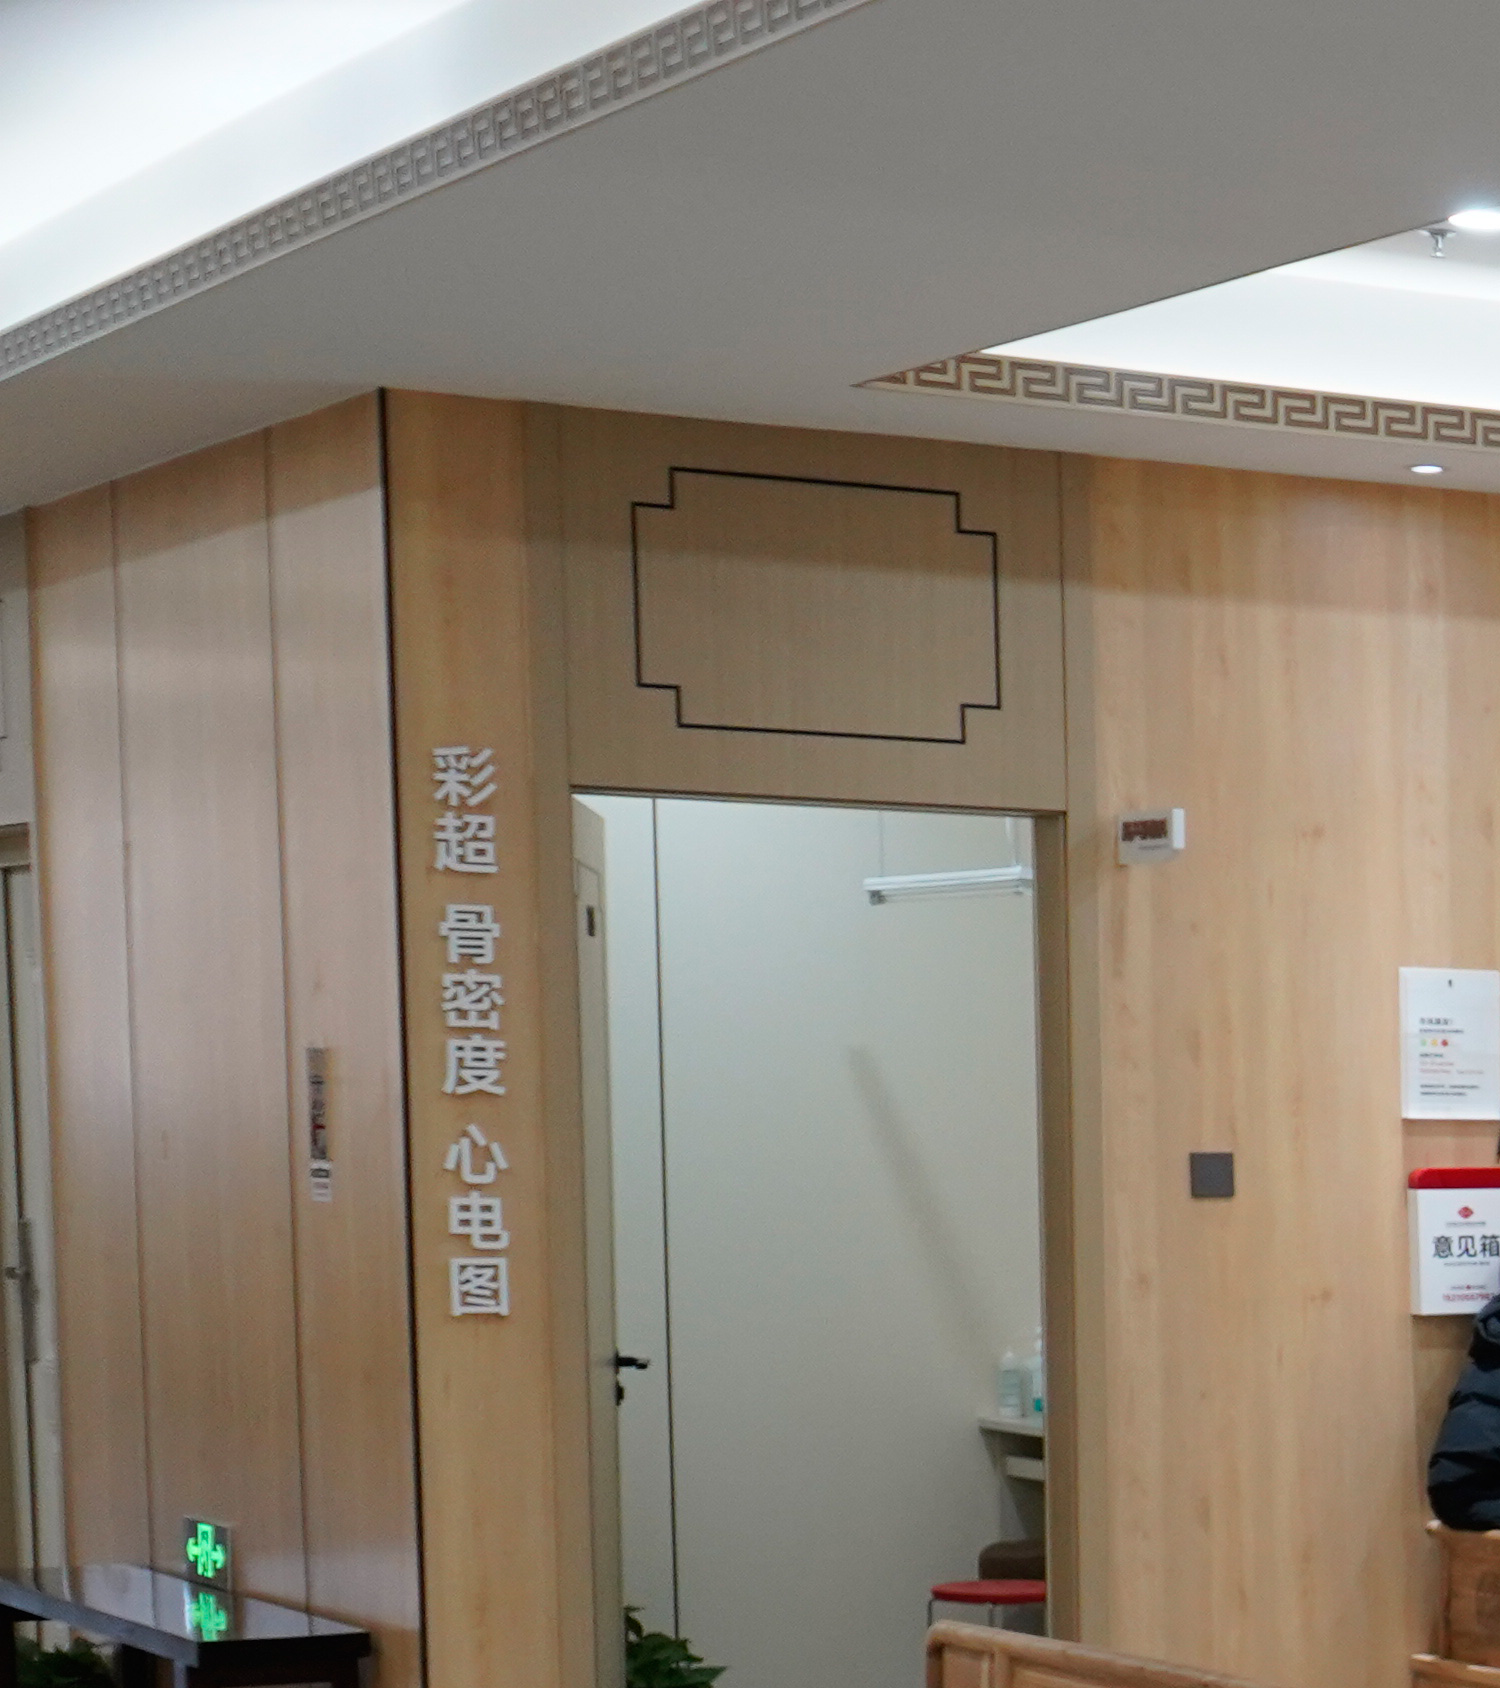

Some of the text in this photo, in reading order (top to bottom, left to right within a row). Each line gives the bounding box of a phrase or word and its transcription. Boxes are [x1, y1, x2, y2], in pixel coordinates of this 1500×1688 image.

[431, 746, 511, 1318] 彩超 骨密度 心电图
[1432, 1234, 1500, 1259] 意见箱
